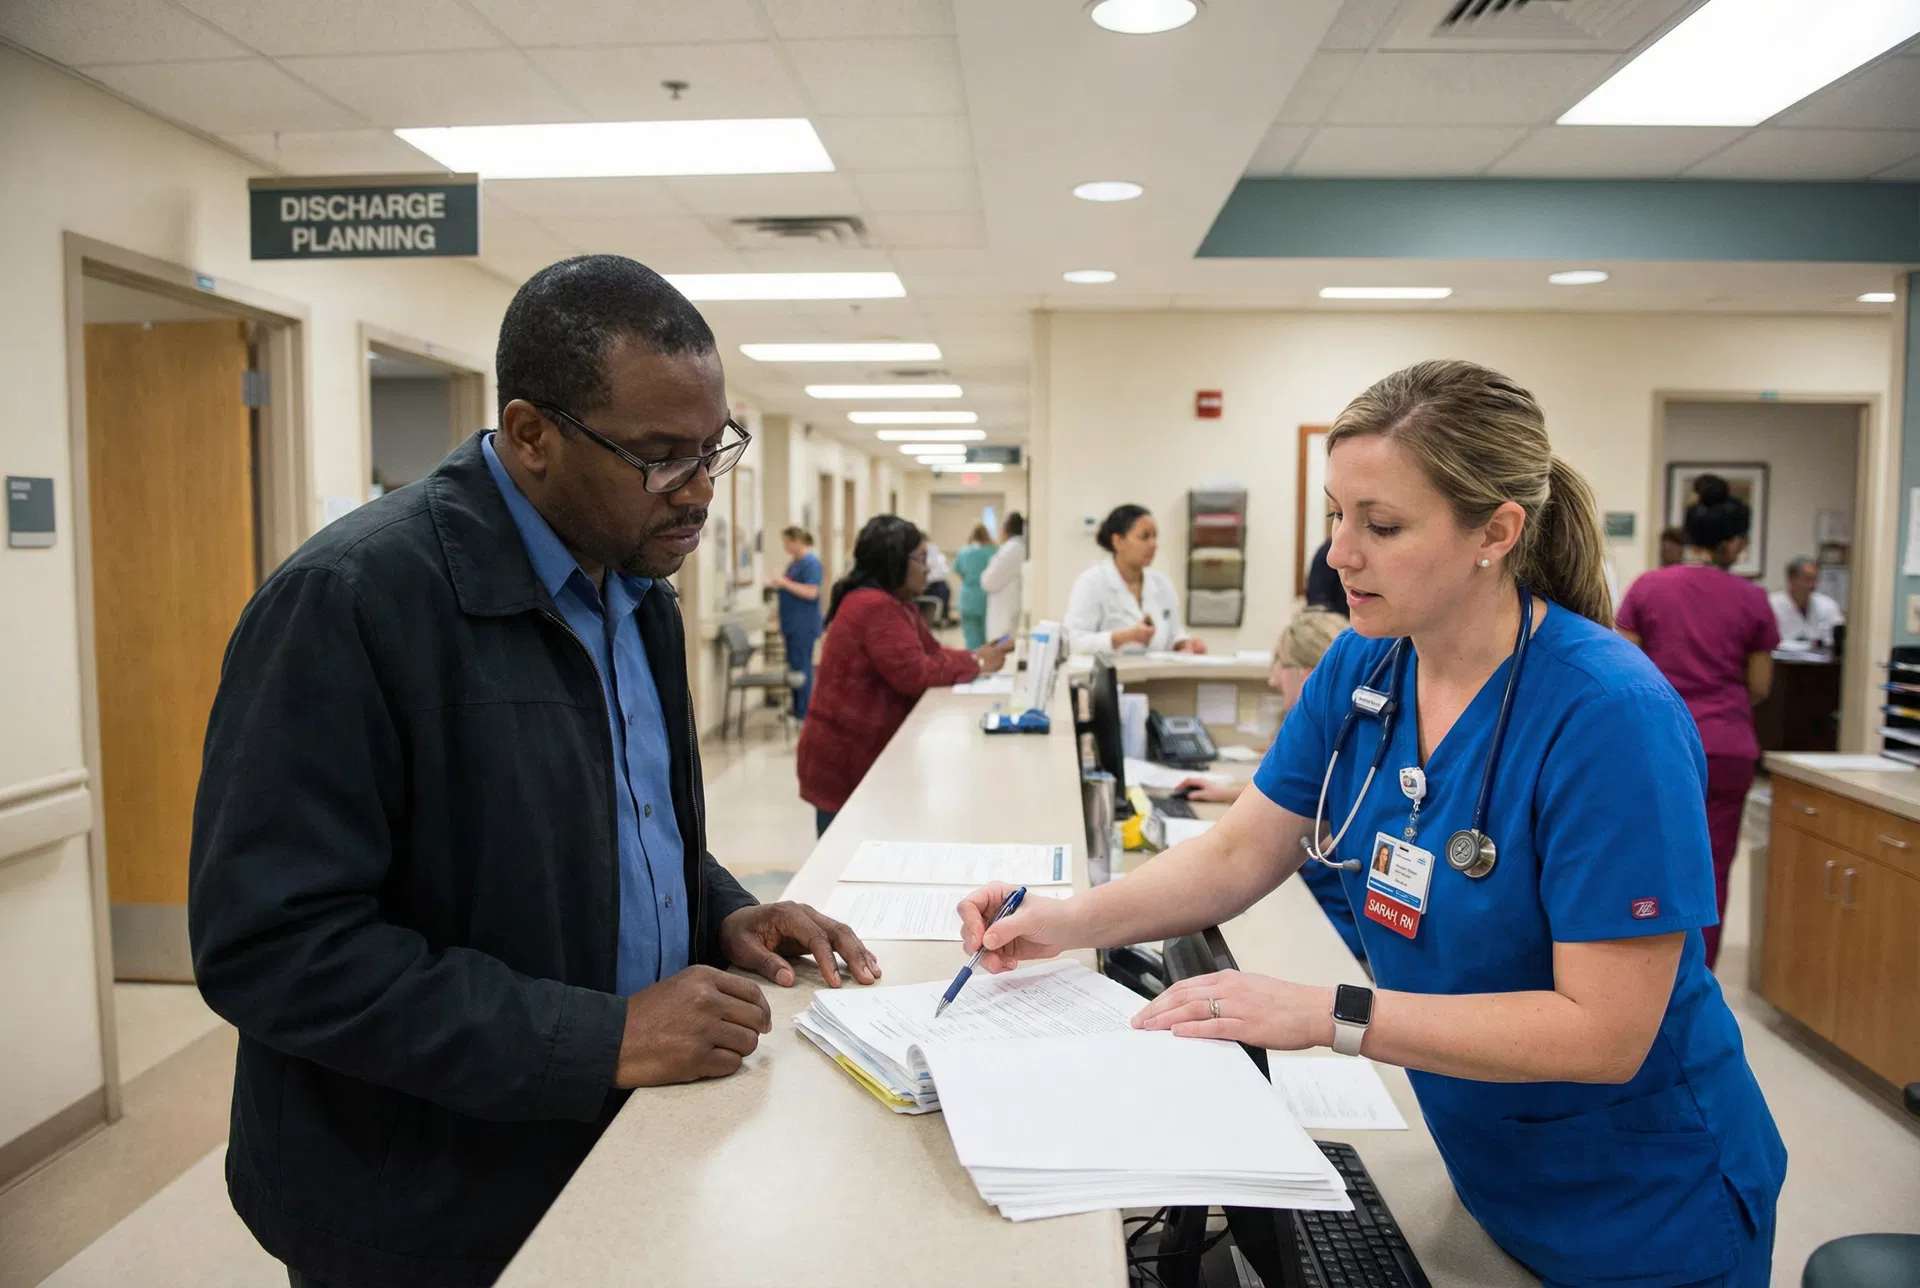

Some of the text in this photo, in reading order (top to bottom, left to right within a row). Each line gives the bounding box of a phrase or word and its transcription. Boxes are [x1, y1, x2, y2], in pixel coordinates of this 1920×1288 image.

[280, 193, 446, 222] DISCHARGE
[291, 223, 436, 252] PLANNING
[1368, 899, 1414, 930] SARAH, RN
